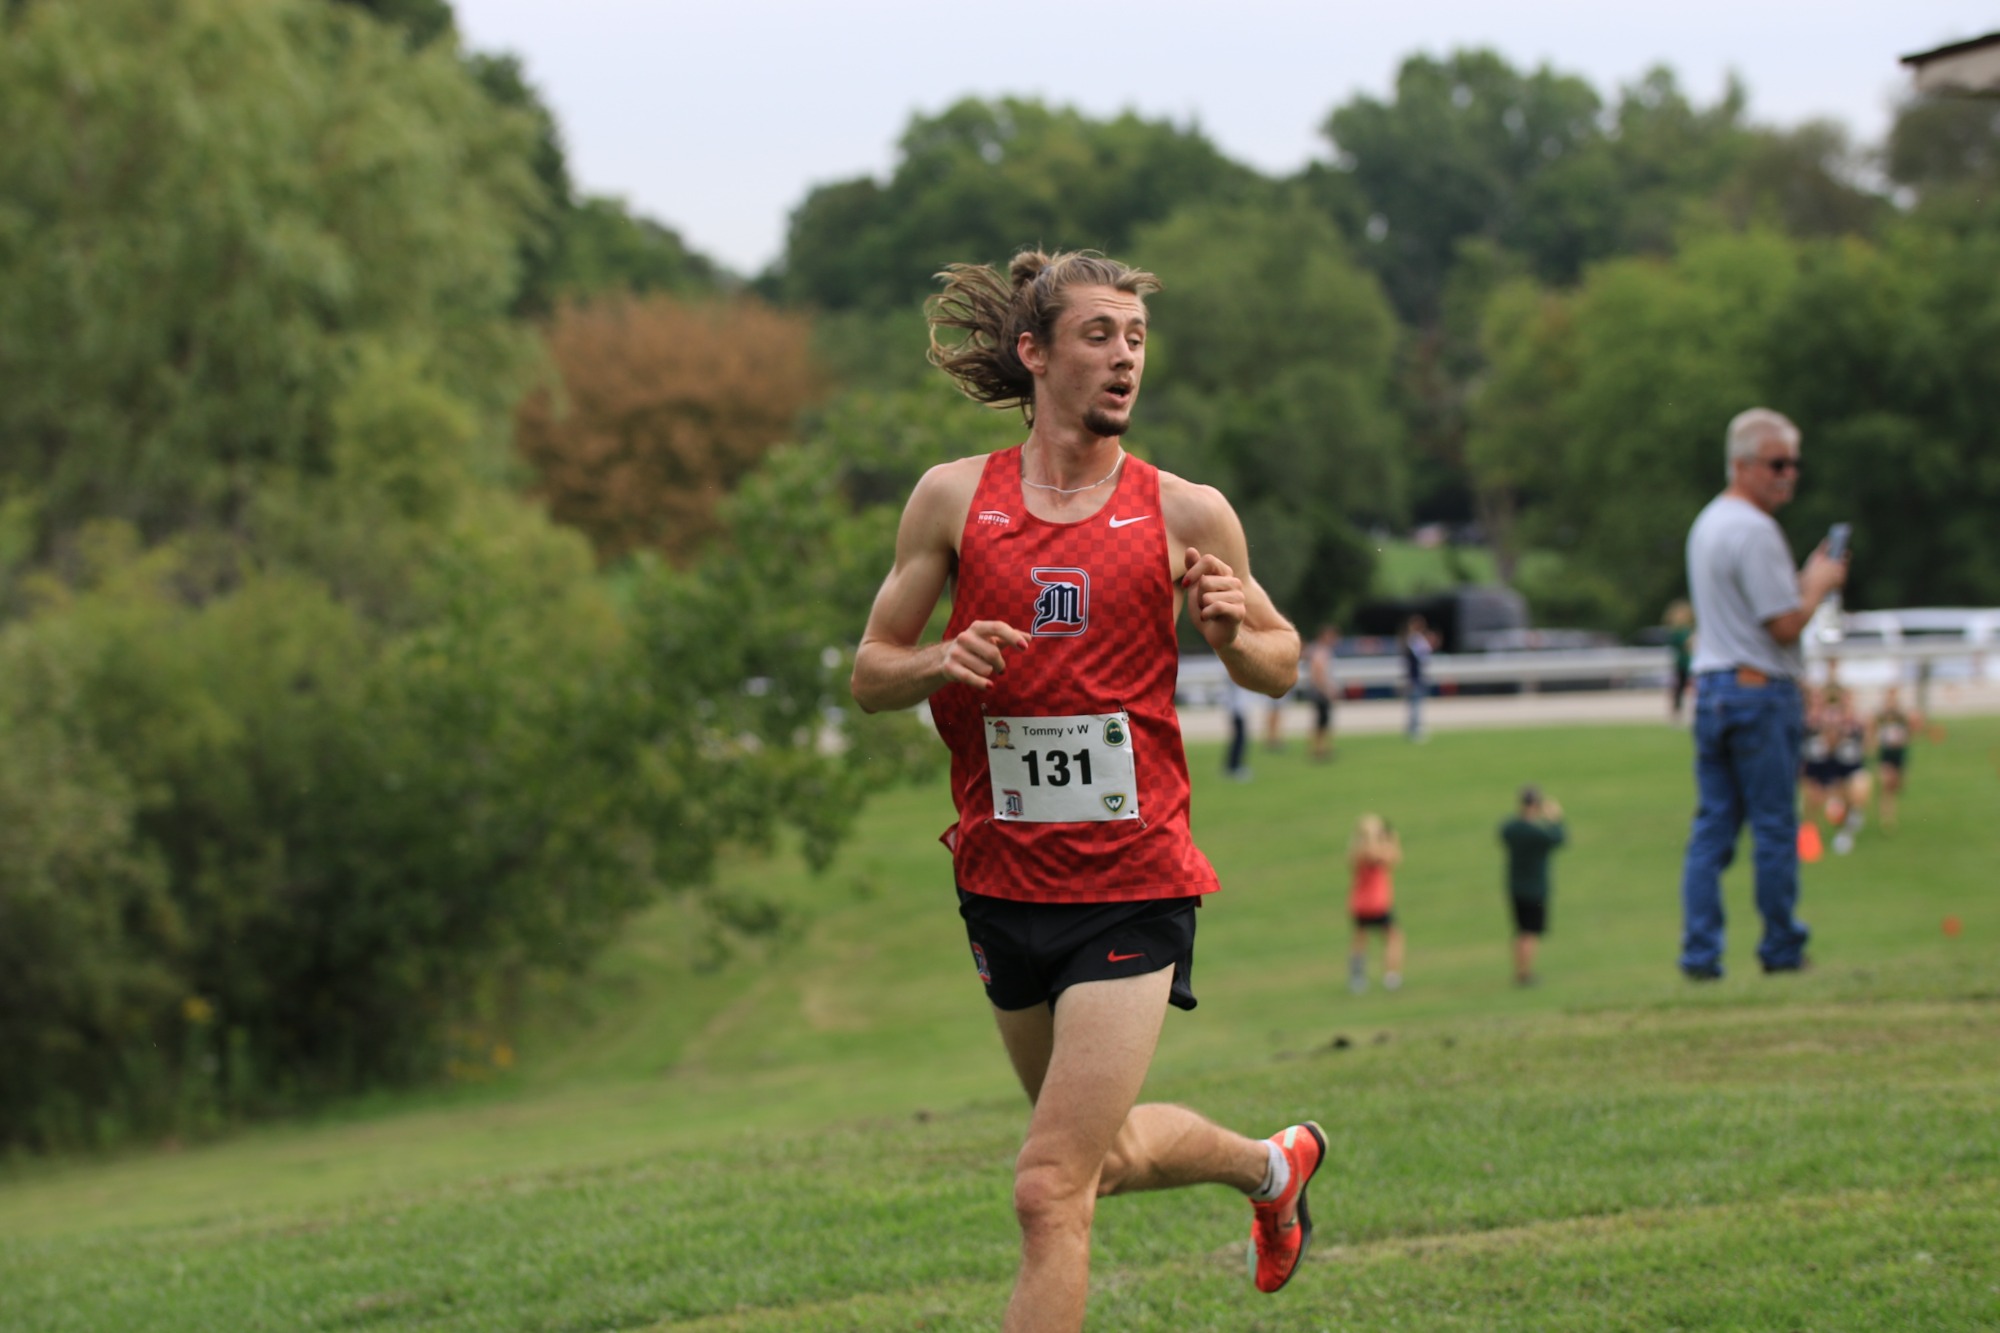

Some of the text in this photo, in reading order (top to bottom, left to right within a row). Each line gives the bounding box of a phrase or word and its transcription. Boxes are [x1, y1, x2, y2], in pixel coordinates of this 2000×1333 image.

[978, 514, 1010, 524] HORIZON
[1021, 724, 1089, 738] Tommy v W
[1021, 748, 1092, 787] 131
